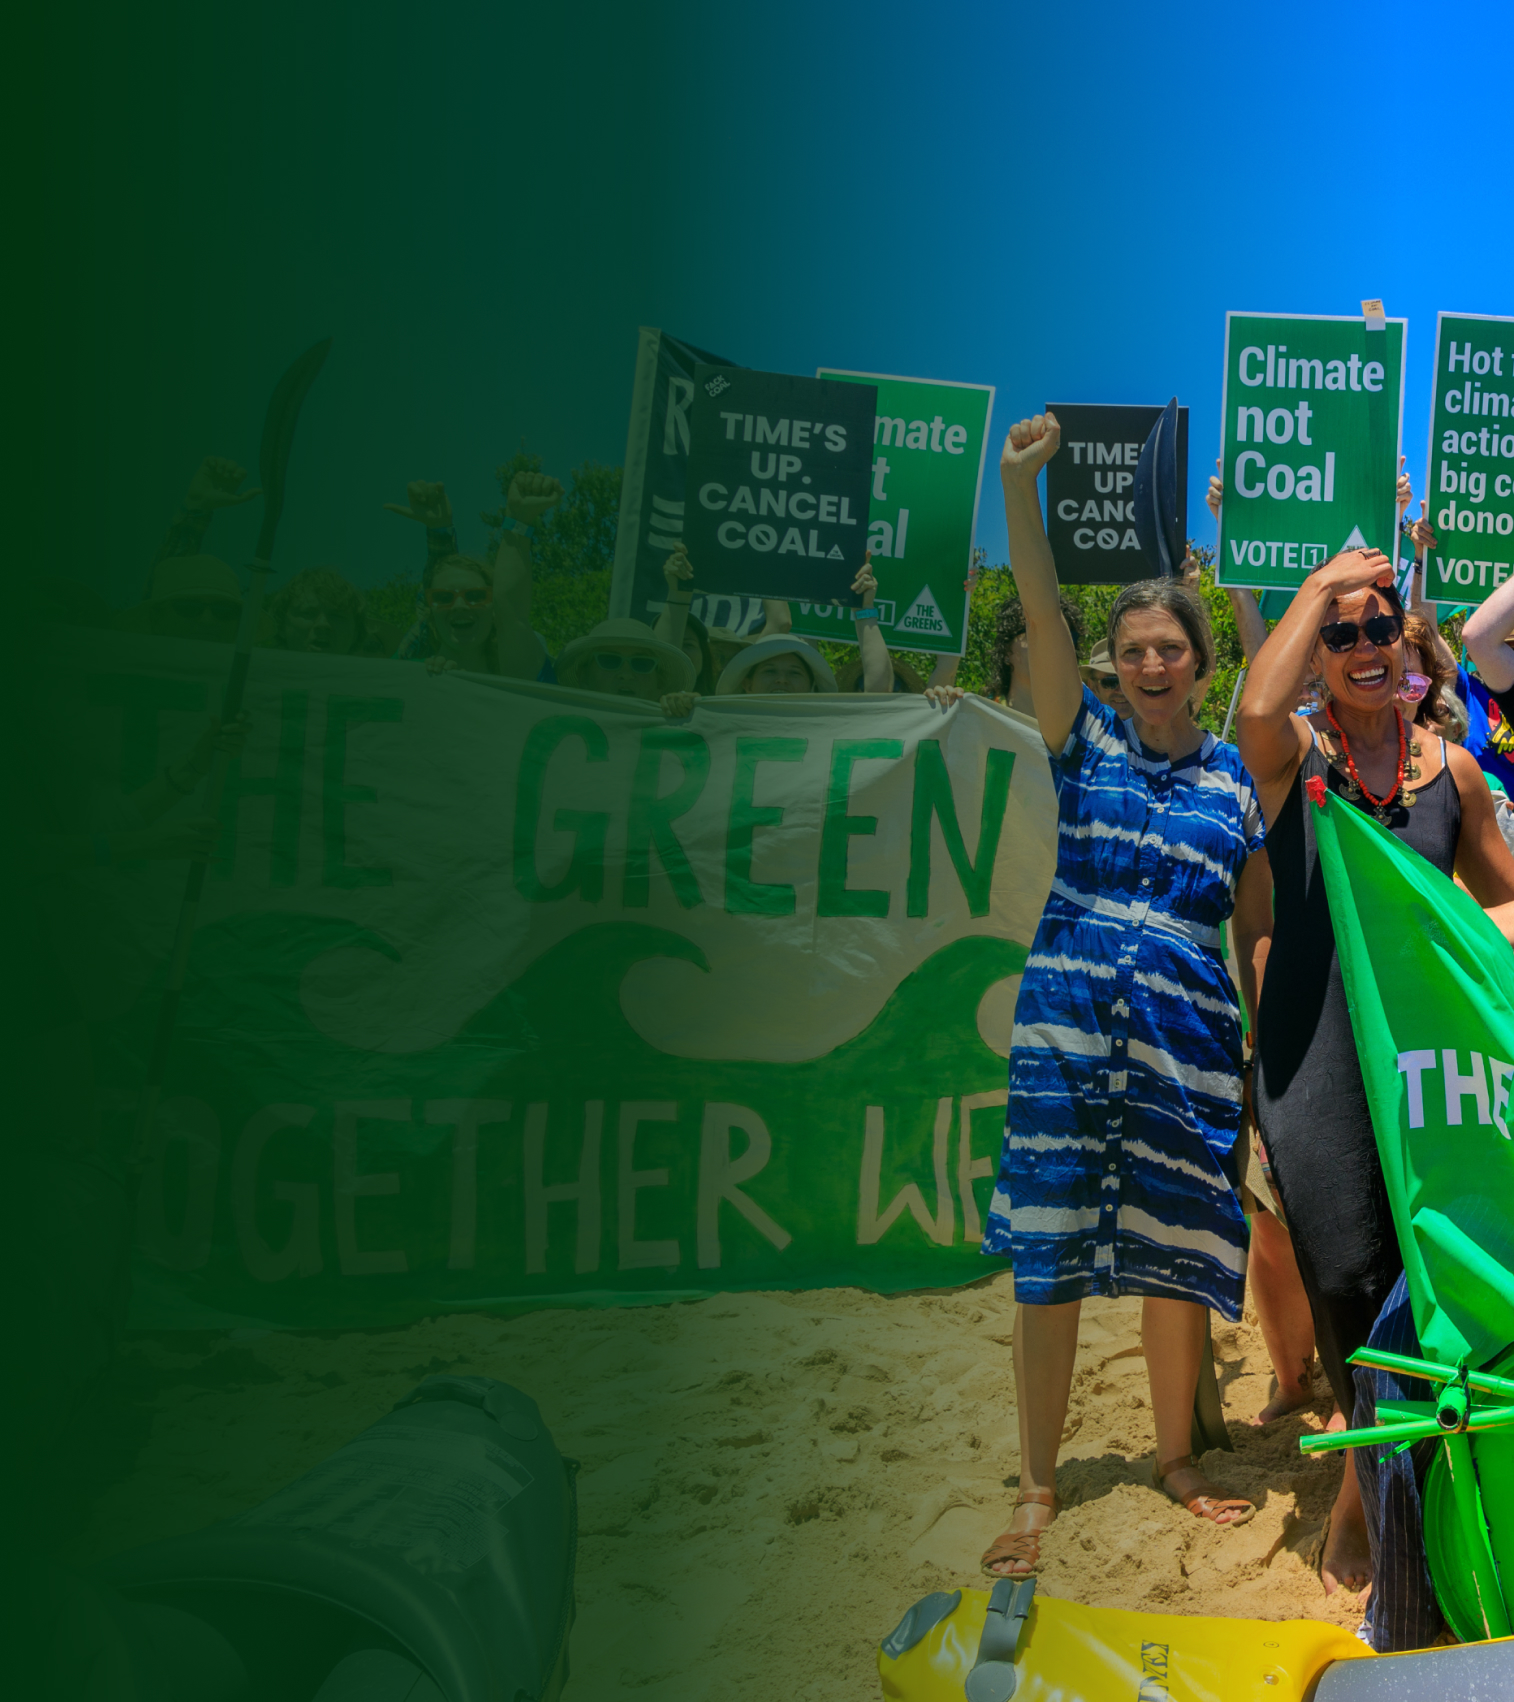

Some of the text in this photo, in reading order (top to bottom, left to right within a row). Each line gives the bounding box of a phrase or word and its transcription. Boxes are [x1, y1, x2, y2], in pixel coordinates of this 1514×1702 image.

[1238, 344, 1386, 392] Climate
[1447, 341, 1503, 377] Hot
[720, 411, 847, 453] TIME'S
[873, 415, 967, 455] mate
[1235, 401, 1313, 446] not
[750, 451, 812, 485] UP.
[1234, 450, 1336, 502] Coal
[1440, 461, 1486, 505] big
[698, 482, 857, 526] CANCEL
[717, 520, 826, 559] COAL
[867, 508, 909, 559] al
[1073, 527, 1142, 550] COA
[1229, 539, 1318, 569] VOTE 1
[1435, 556, 1510, 588] VOTE
[903, 616, 943, 632] GREENS
[915, 603, 935, 618] THE
[512, 715, 1017, 919] GREEN
[1397, 1047, 1514, 1140] THE
[136, 1093, 793, 1283] OGETHER
